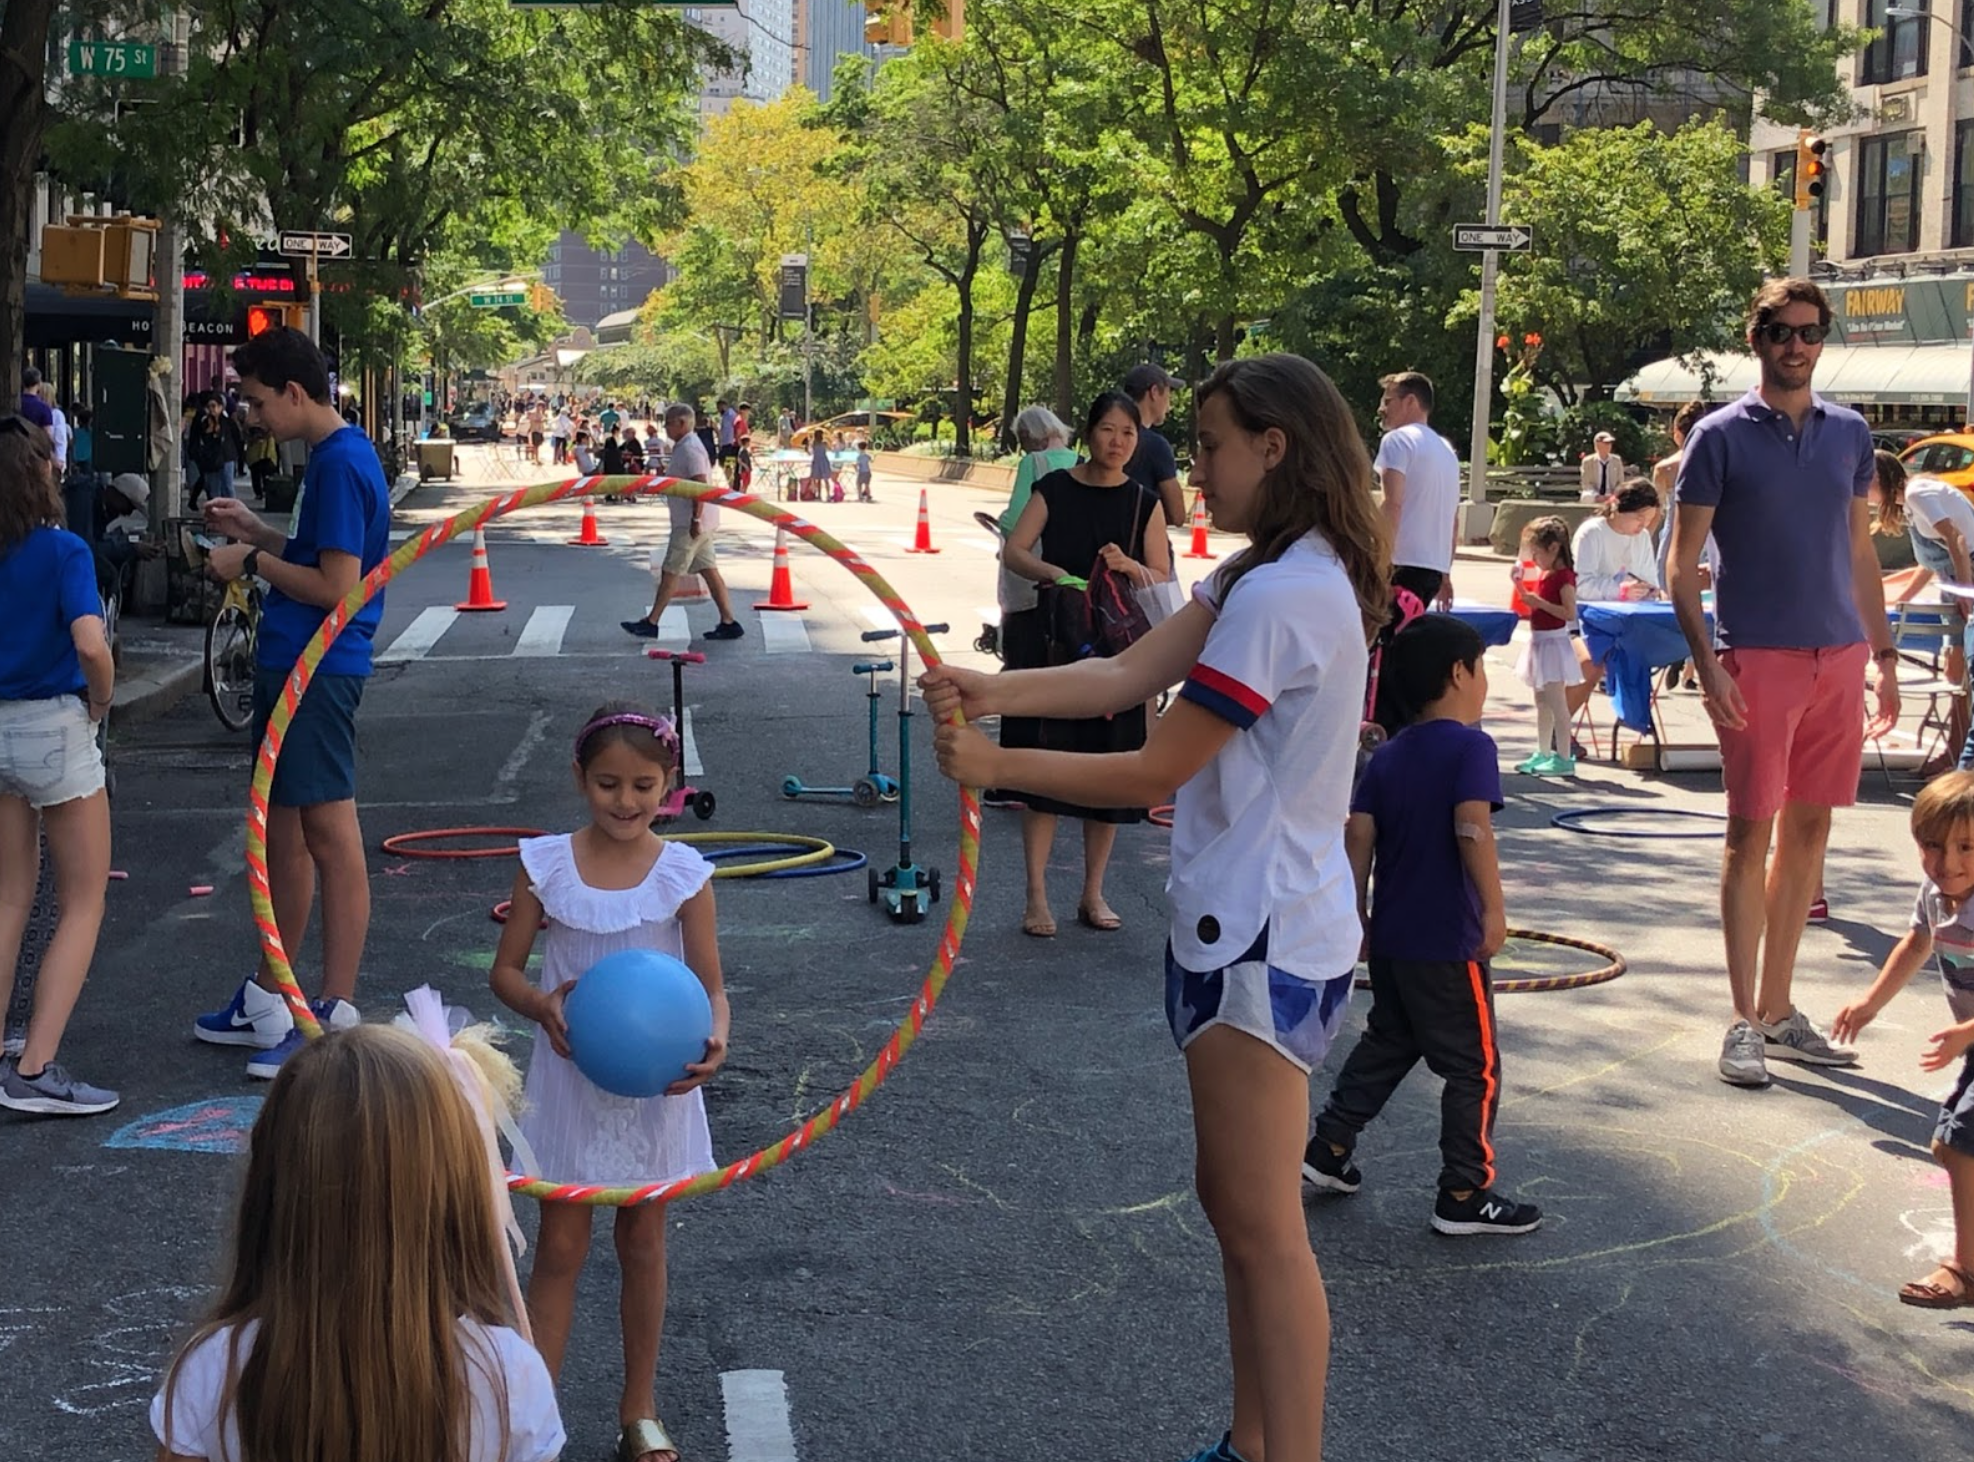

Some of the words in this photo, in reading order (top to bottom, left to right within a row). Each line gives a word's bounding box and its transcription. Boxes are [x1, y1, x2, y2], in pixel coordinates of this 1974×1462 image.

[80, 46, 95, 70] W
[104, 47, 126, 72] 75
[134, 49, 147, 65] St
[285, 239, 307, 249] ONE
[318, 240, 341, 250] WAY
[1461, 232, 1483, 243] ONE
[1496, 233, 1520, 243] WAY
[1845, 288, 1905, 317] FAIRWAY
[1479, 1201, 1502, 1220] N
